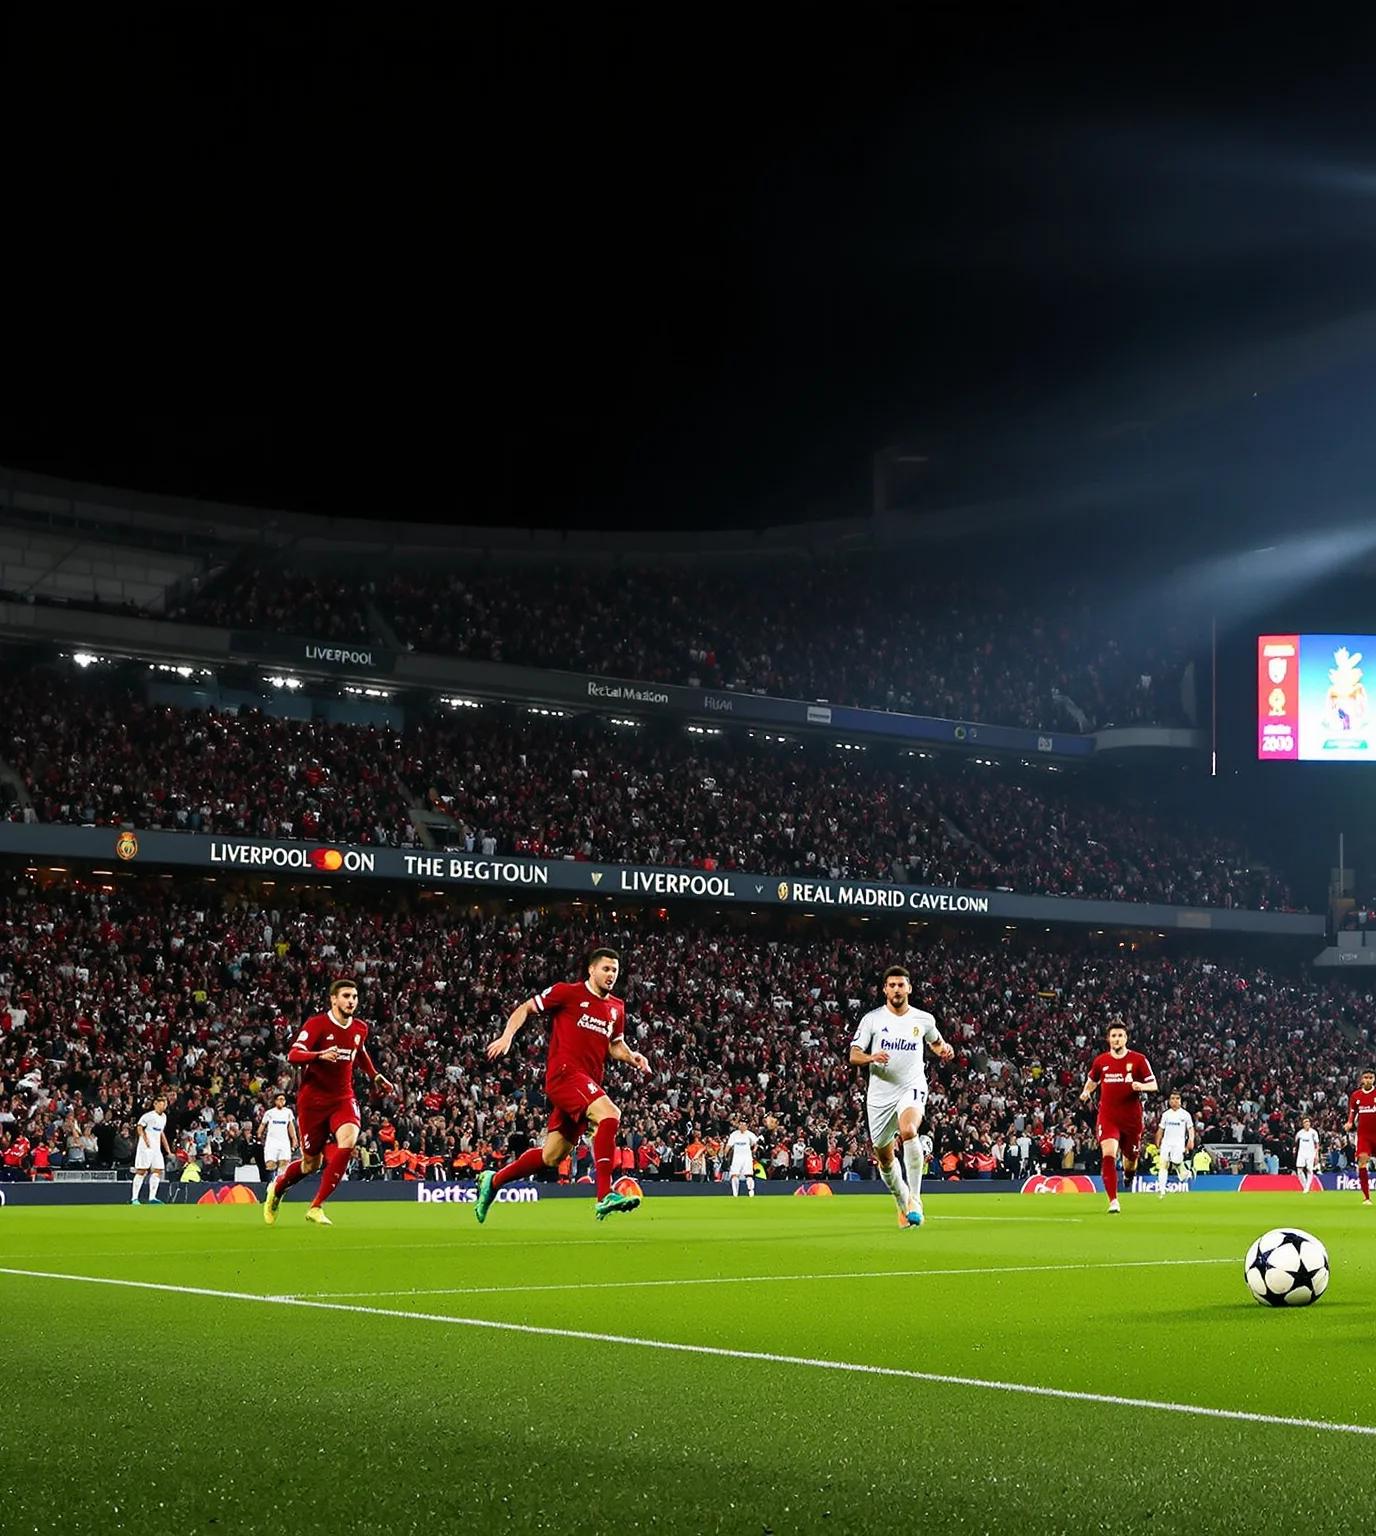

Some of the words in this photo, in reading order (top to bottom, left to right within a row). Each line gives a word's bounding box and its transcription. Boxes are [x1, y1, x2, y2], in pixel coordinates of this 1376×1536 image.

[305, 645, 376, 667] LIVERPOOL
[210, 843, 312, 868] LIVERPOOL
[344, 851, 375, 872] ON
[404, 855, 444, 877] THE
[450, 859, 548, 884] BEGTOUN
[621, 870, 735, 896] LIVERPOOL
[793, 883, 834, 904] REAL
[838, 887, 905, 908] MADRID
[909, 892, 989, 913] CAVELONN
